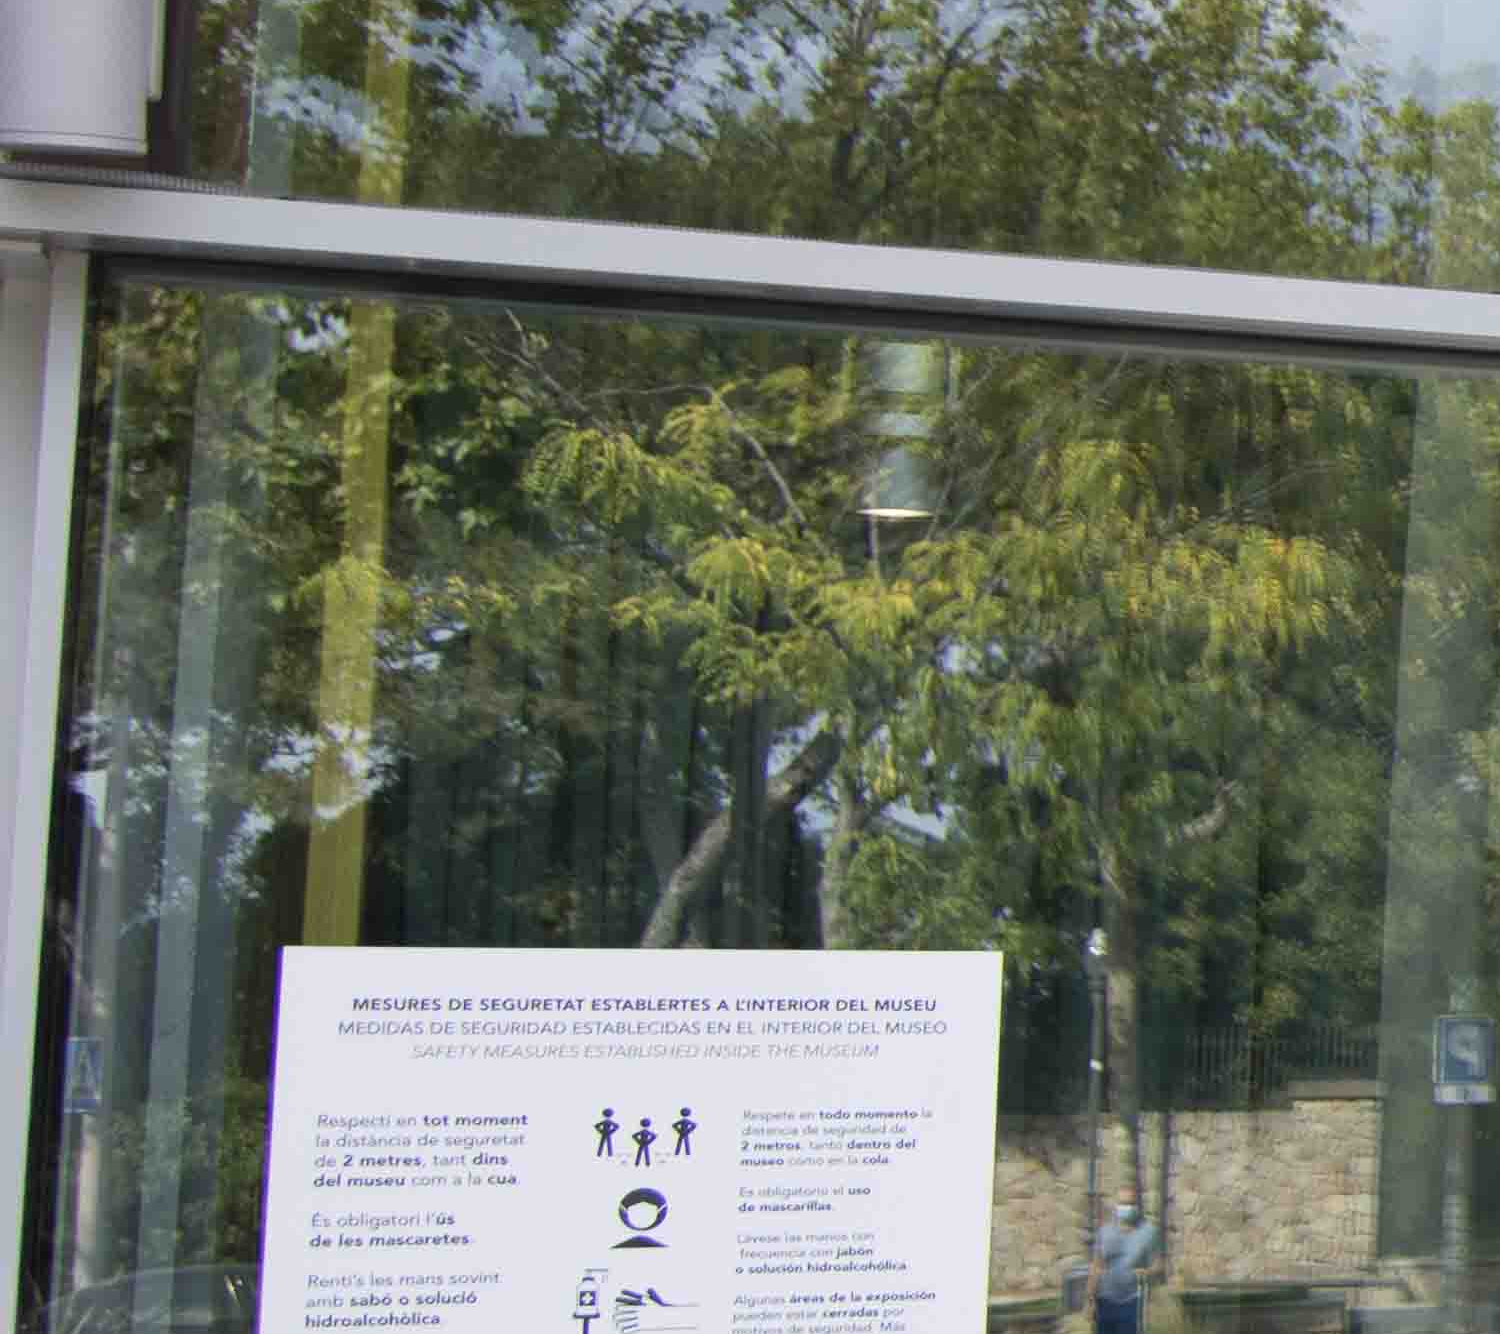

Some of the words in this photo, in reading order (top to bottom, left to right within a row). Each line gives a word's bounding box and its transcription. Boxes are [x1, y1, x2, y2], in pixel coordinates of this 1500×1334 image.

[352, 997, 442, 1011] MESURES
[447, 997, 473, 1011] DE
[478, 997, 585, 1011] SEGURETAT
[590, 997, 711, 1012] ESTABLERTES
[715, 998, 729, 1011] A
[834, 998, 869, 1012] DEL
[873, 998, 936, 1011] MUSEU
[337, 1019, 424, 1035] MEDIDAS
[428, 1020, 456, 1035] DE
[460, 1020, 567, 1035] SEGURIDAD
[572, 1020, 701, 1035] ESTABLECIDAS
[706, 1020, 731, 1035] EN
[735, 1019, 753, 1035] EL
[761, 1019, 843, 1035] INTERIOR
[846, 1018, 880, 1035] DEL
[884, 1018, 947, 1035] MUSEO
[316, 1114, 390, 1131] Respecti
[396, 1116, 416, 1126] en
[422, 1114, 449, 1127] tot
[454, 1114, 528, 1126] moment
[315, 1133, 330, 1148] la
[416, 1132, 440, 1147] de
[443, 1133, 525, 1150] seguretat
[313, 1154, 336, 1168] de
[342, 1153, 353, 1167] 2
[432, 1154, 465, 1166] tant
[471, 1150, 508, 1166] dins
[312, 1172, 342, 1188] del
[346, 1175, 406, 1187] museu
[410, 1175, 446, 1186] com
[452, 1175, 462, 1185] a
[467, 1170, 482, 1185] la
[335, 1211, 420, 1231] obligatori
[308, 1233, 332, 1248] de
[337, 1232, 363, 1248] les
[734, 1266, 744, 1274] o
[747, 1262, 803, 1275] solución
[368, 1271, 393, 1287] les
[398, 1274, 444, 1287] mans
[447, 1272, 499, 1284] sovint
[305, 1294, 344, 1307] amb
[349, 1292, 393, 1307] sabó
[397, 1295, 410, 1306] o
[414, 1289, 478, 1305] solució
[788, 1293, 825, 1304] áreas
[827, 1291, 846, 1304] de
[849, 1289, 862, 1303] la
[864, 1290, 936, 1304] exposición
